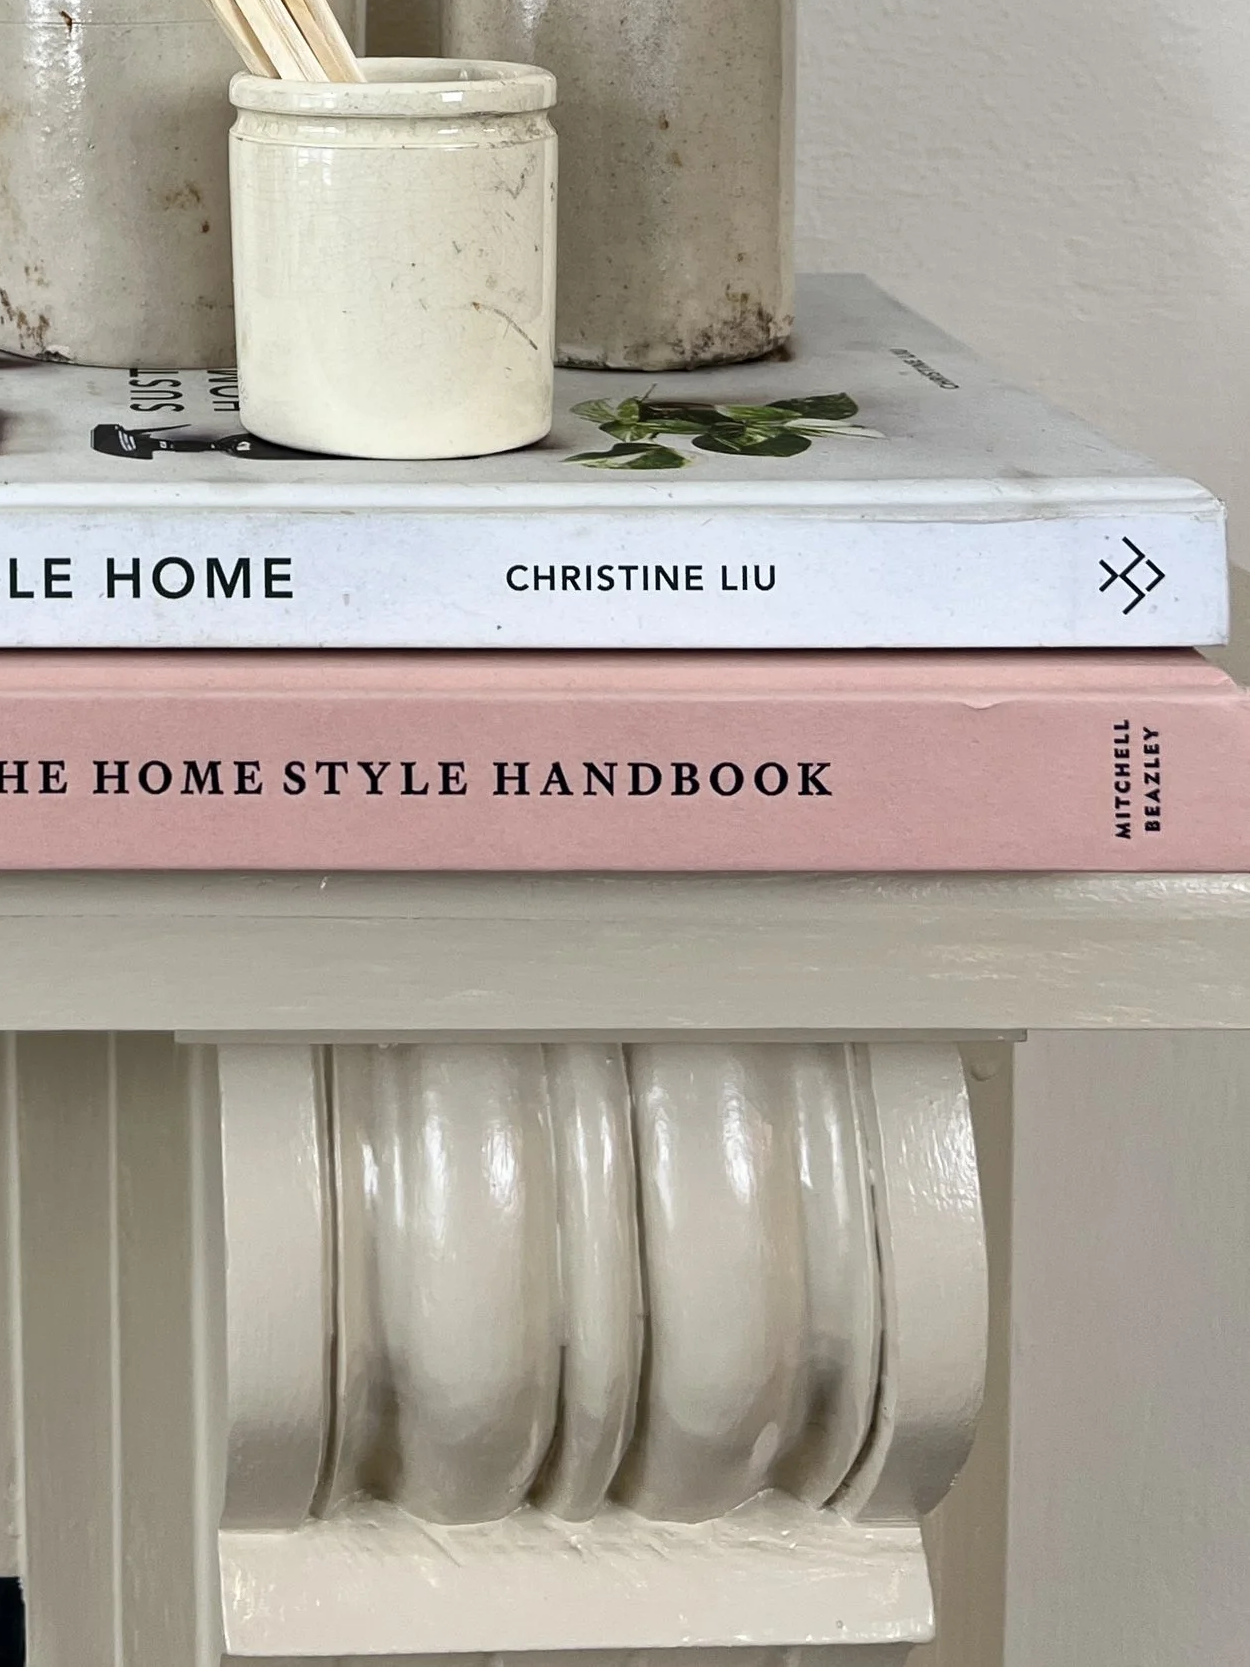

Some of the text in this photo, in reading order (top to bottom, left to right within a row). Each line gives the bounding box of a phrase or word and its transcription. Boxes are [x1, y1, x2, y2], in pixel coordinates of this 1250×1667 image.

[106, 556, 294, 600] HOME
[506, 564, 776, 592] CHRISTINE LIU
[92, 759, 263, 796] HOME
[282, 760, 468, 796] STYLE
[492, 761, 833, 797] HANDBOOK
[1113, 719, 1132, 840] MITCHELL
[1142, 726, 1161, 832] BEAZLEY
